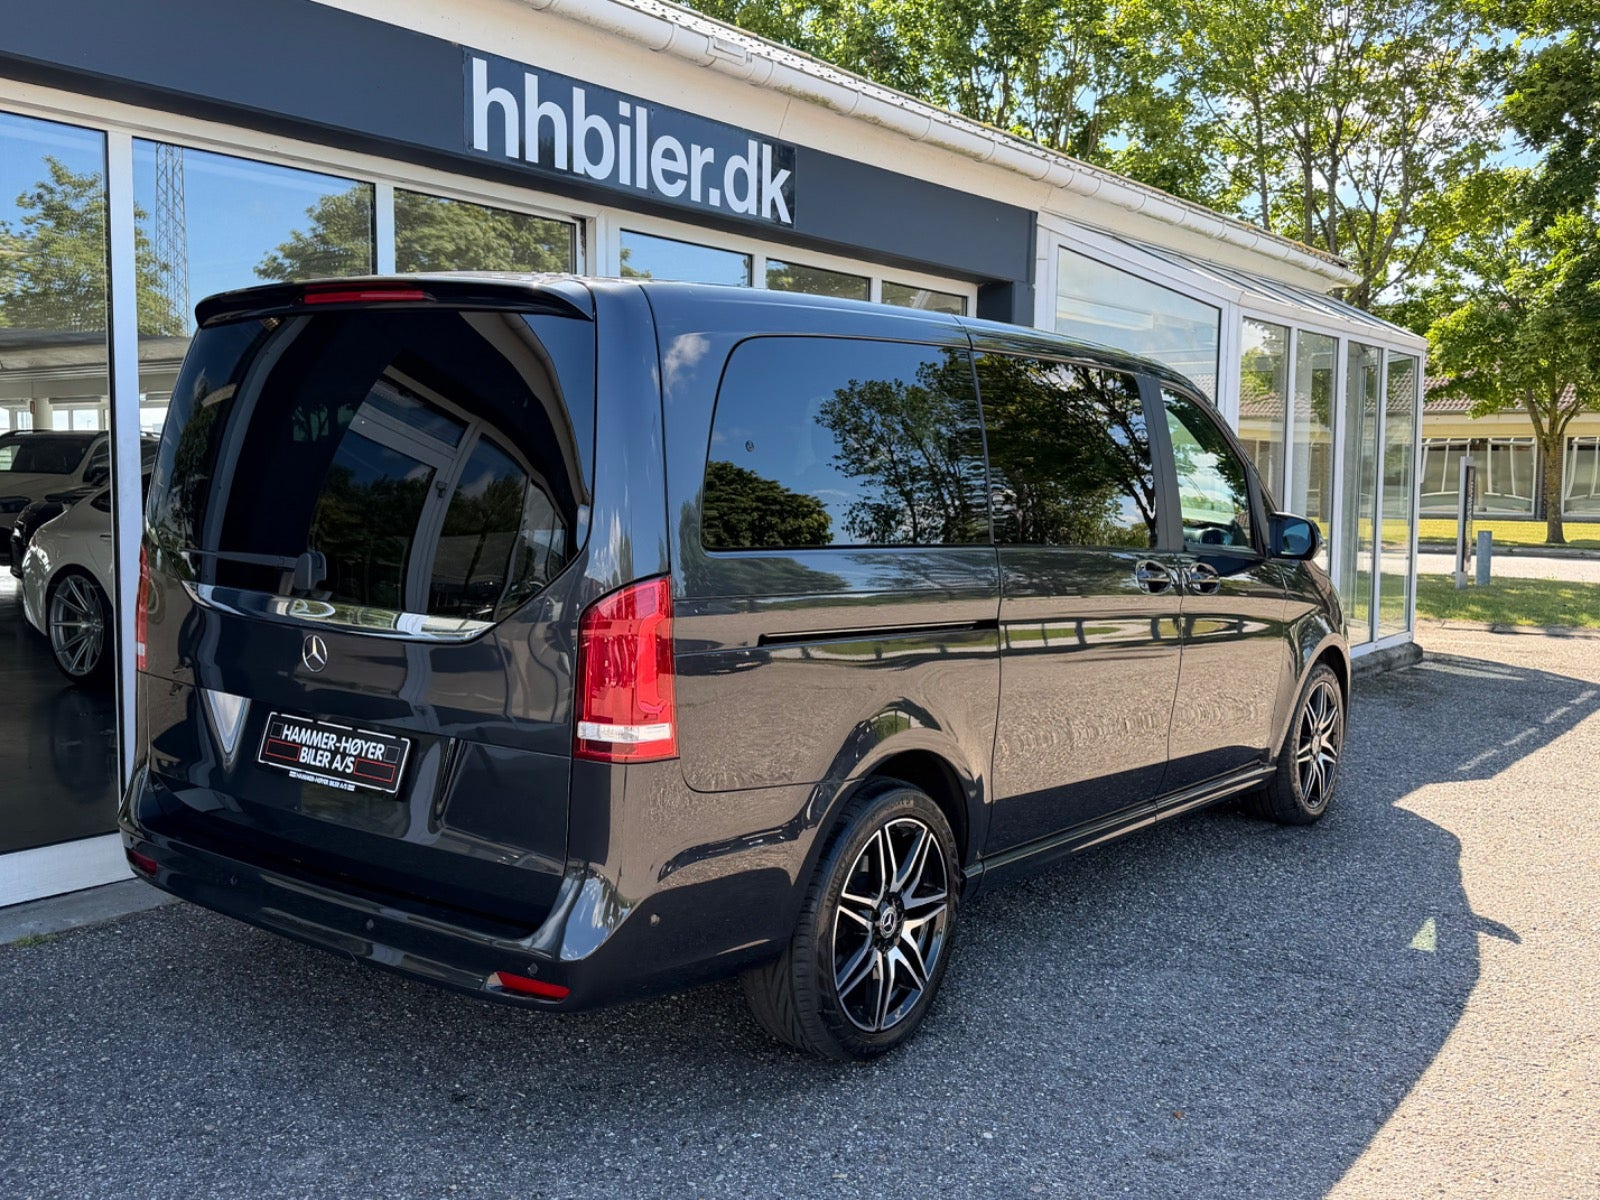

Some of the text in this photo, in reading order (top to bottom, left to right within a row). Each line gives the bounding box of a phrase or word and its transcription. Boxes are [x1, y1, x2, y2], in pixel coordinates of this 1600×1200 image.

[472, 57, 792, 224] hhbiler.dk
[282, 724, 385, 760] HAMMER-HØYER
[299, 747, 355, 774] BILER A/S
